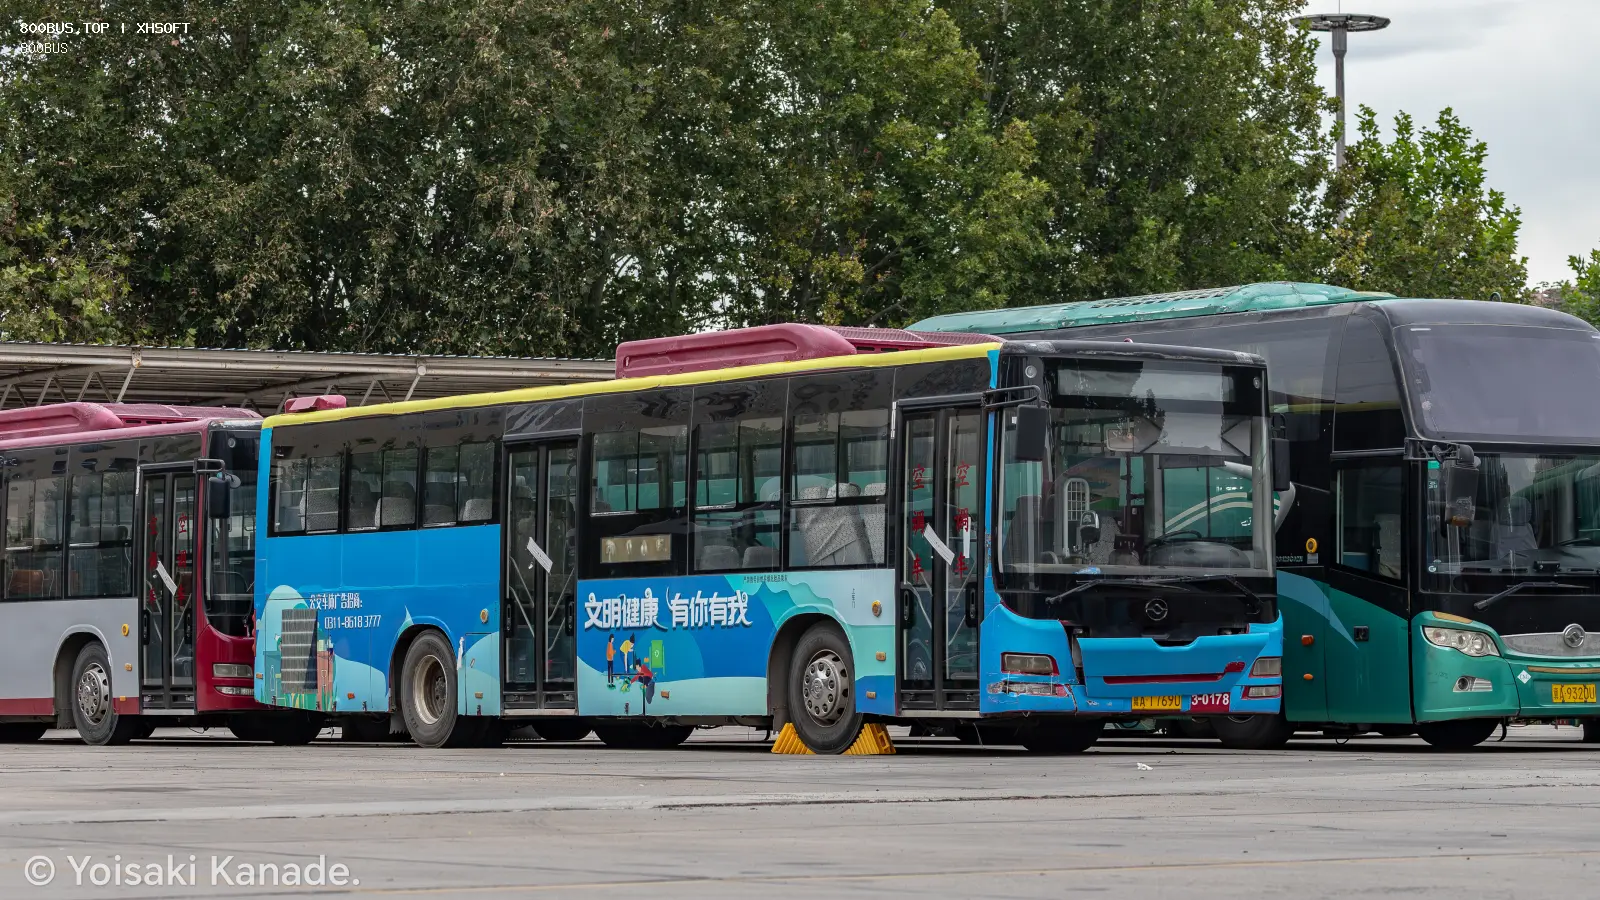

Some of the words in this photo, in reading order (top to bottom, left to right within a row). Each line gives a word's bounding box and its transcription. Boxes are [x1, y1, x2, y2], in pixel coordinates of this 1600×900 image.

[584, 587, 669, 631] 文明健康
[665, 586, 753, 629] 有你有我
[1191, 693, 1230, 706] 3-0178
